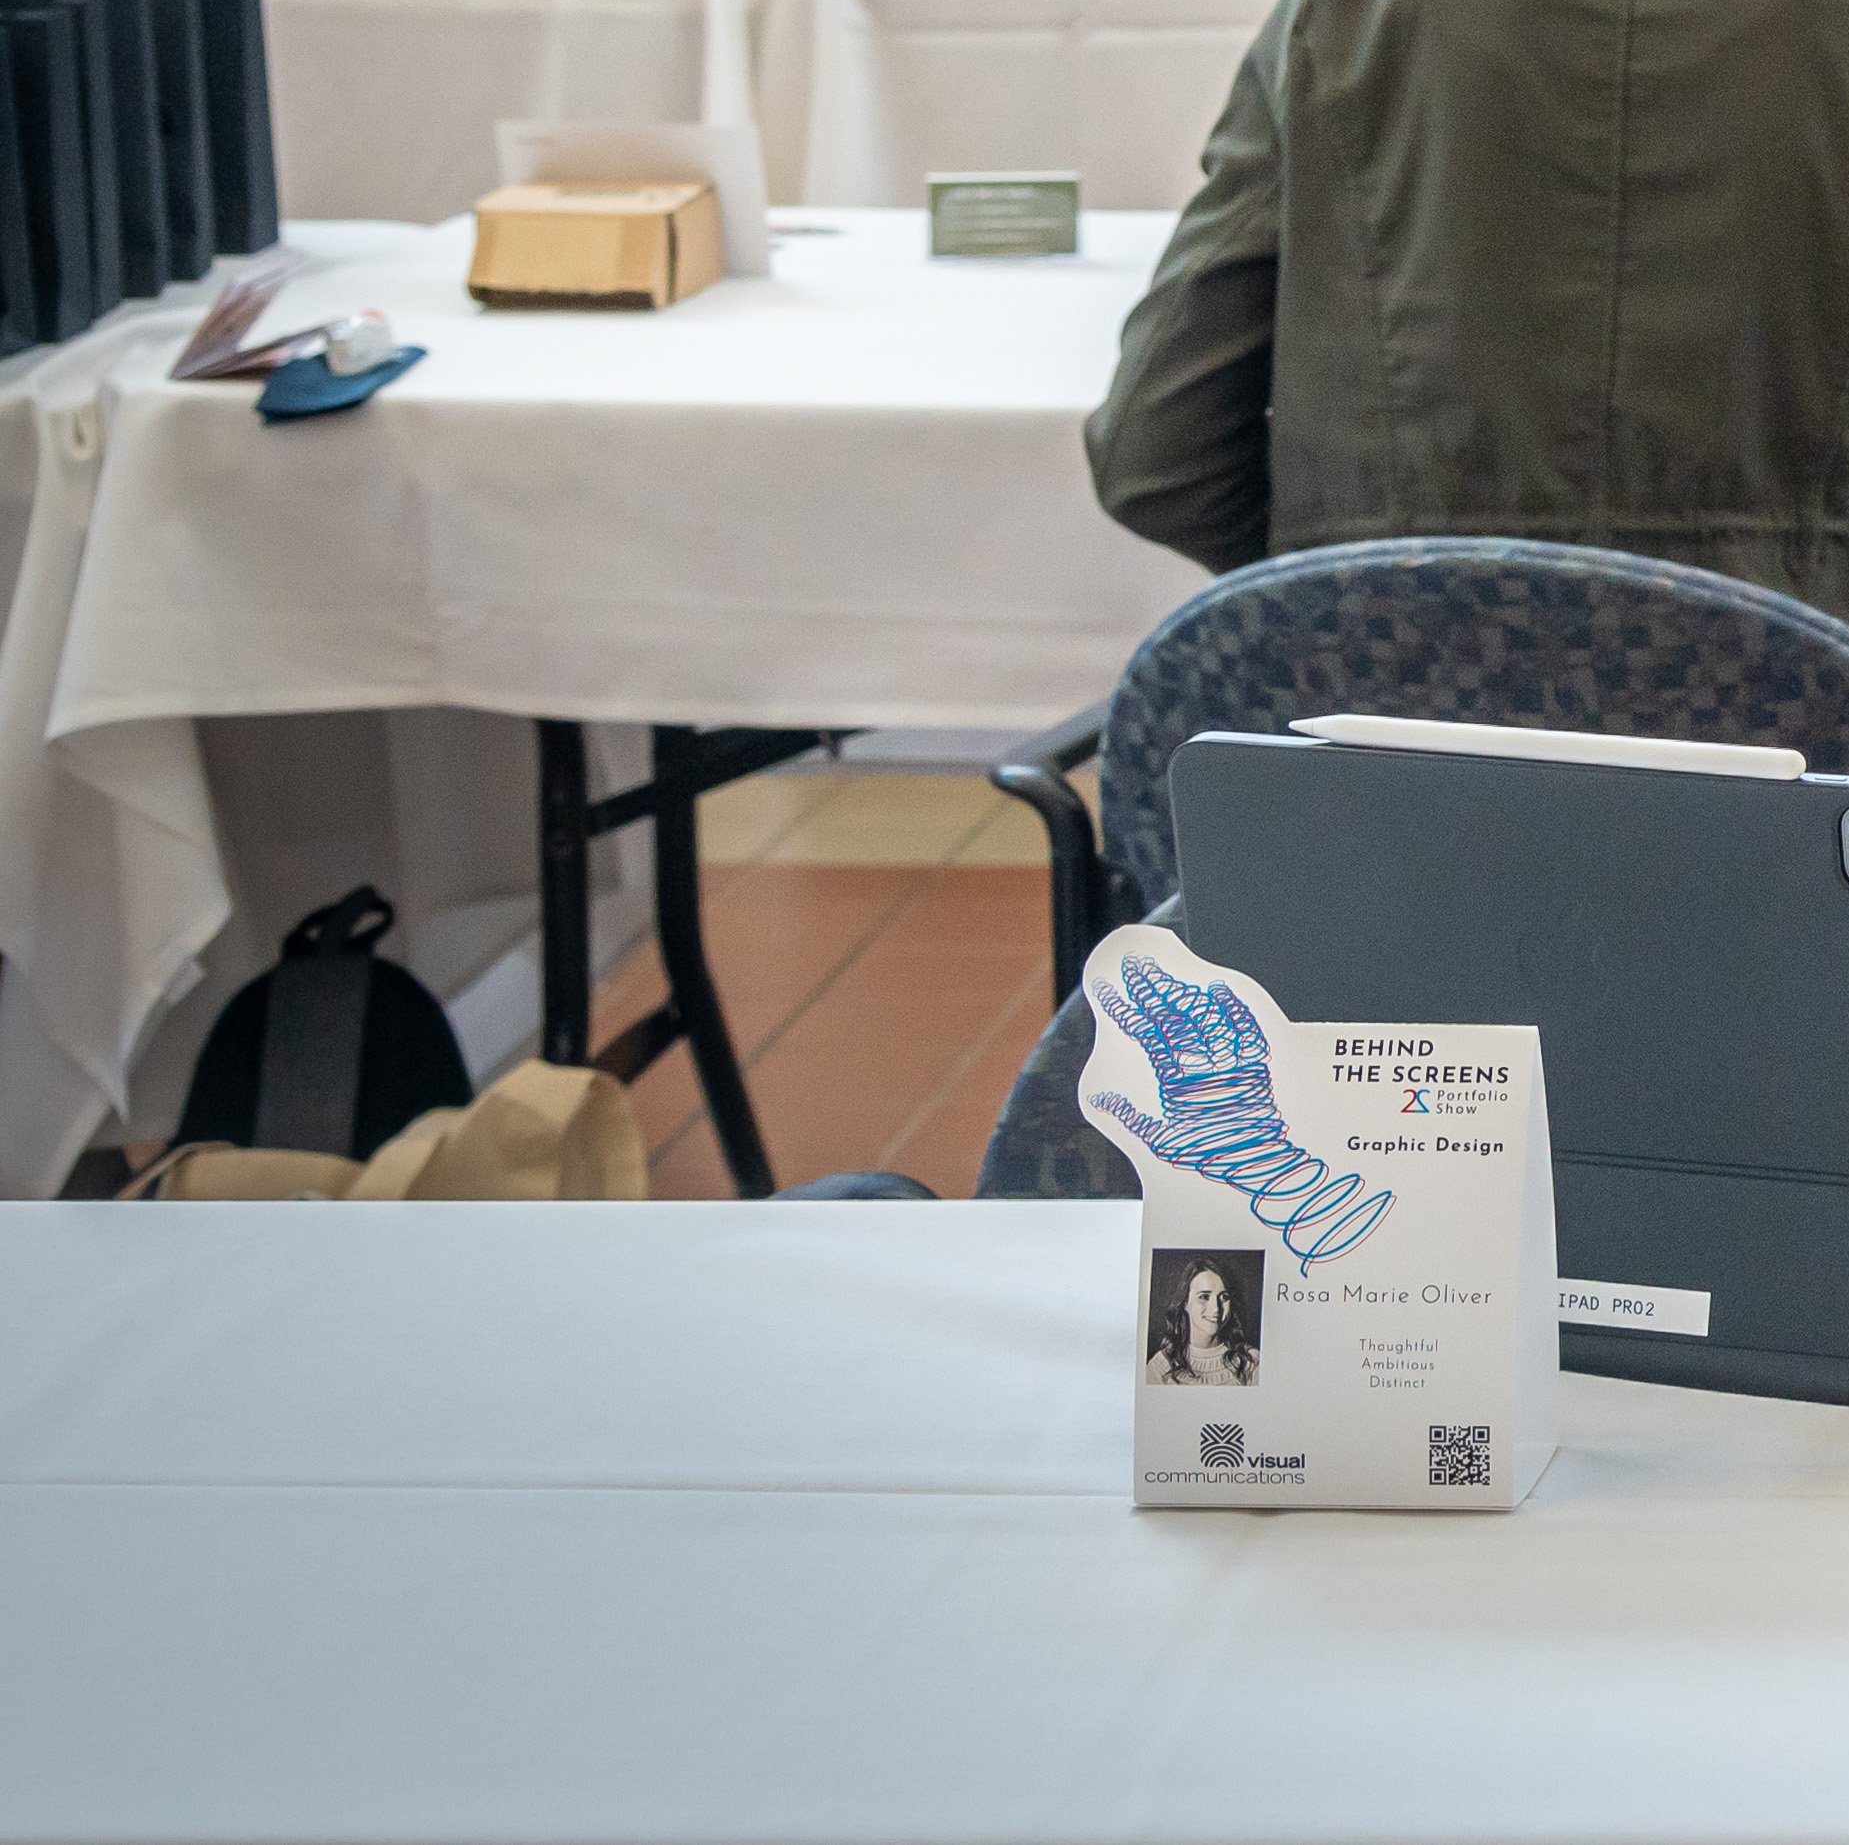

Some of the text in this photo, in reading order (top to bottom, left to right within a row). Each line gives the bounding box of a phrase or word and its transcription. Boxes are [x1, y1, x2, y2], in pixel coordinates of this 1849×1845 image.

[1335, 1039, 1434, 1057] BEHIND
[1333, 1064, 1509, 1084] THE SCREENS
[1437, 1089, 1508, 1102] Portfolio
[1436, 1103, 1477, 1114] Show
[1347, 1136, 1504, 1156] Graphic Design
[1277, 1283, 1492, 1304] Rosa Marie Oliver
[1558, 1293, 1655, 1316] IPAD PRO2
[1359, 1338, 1440, 1355] Thoughtful
[1361, 1357, 1435, 1371] Ambitious
[1369, 1375, 1426, 1389] Distinct
[1248, 1452, 1306, 1470] visual
[1144, 1469, 1306, 1486] communications
